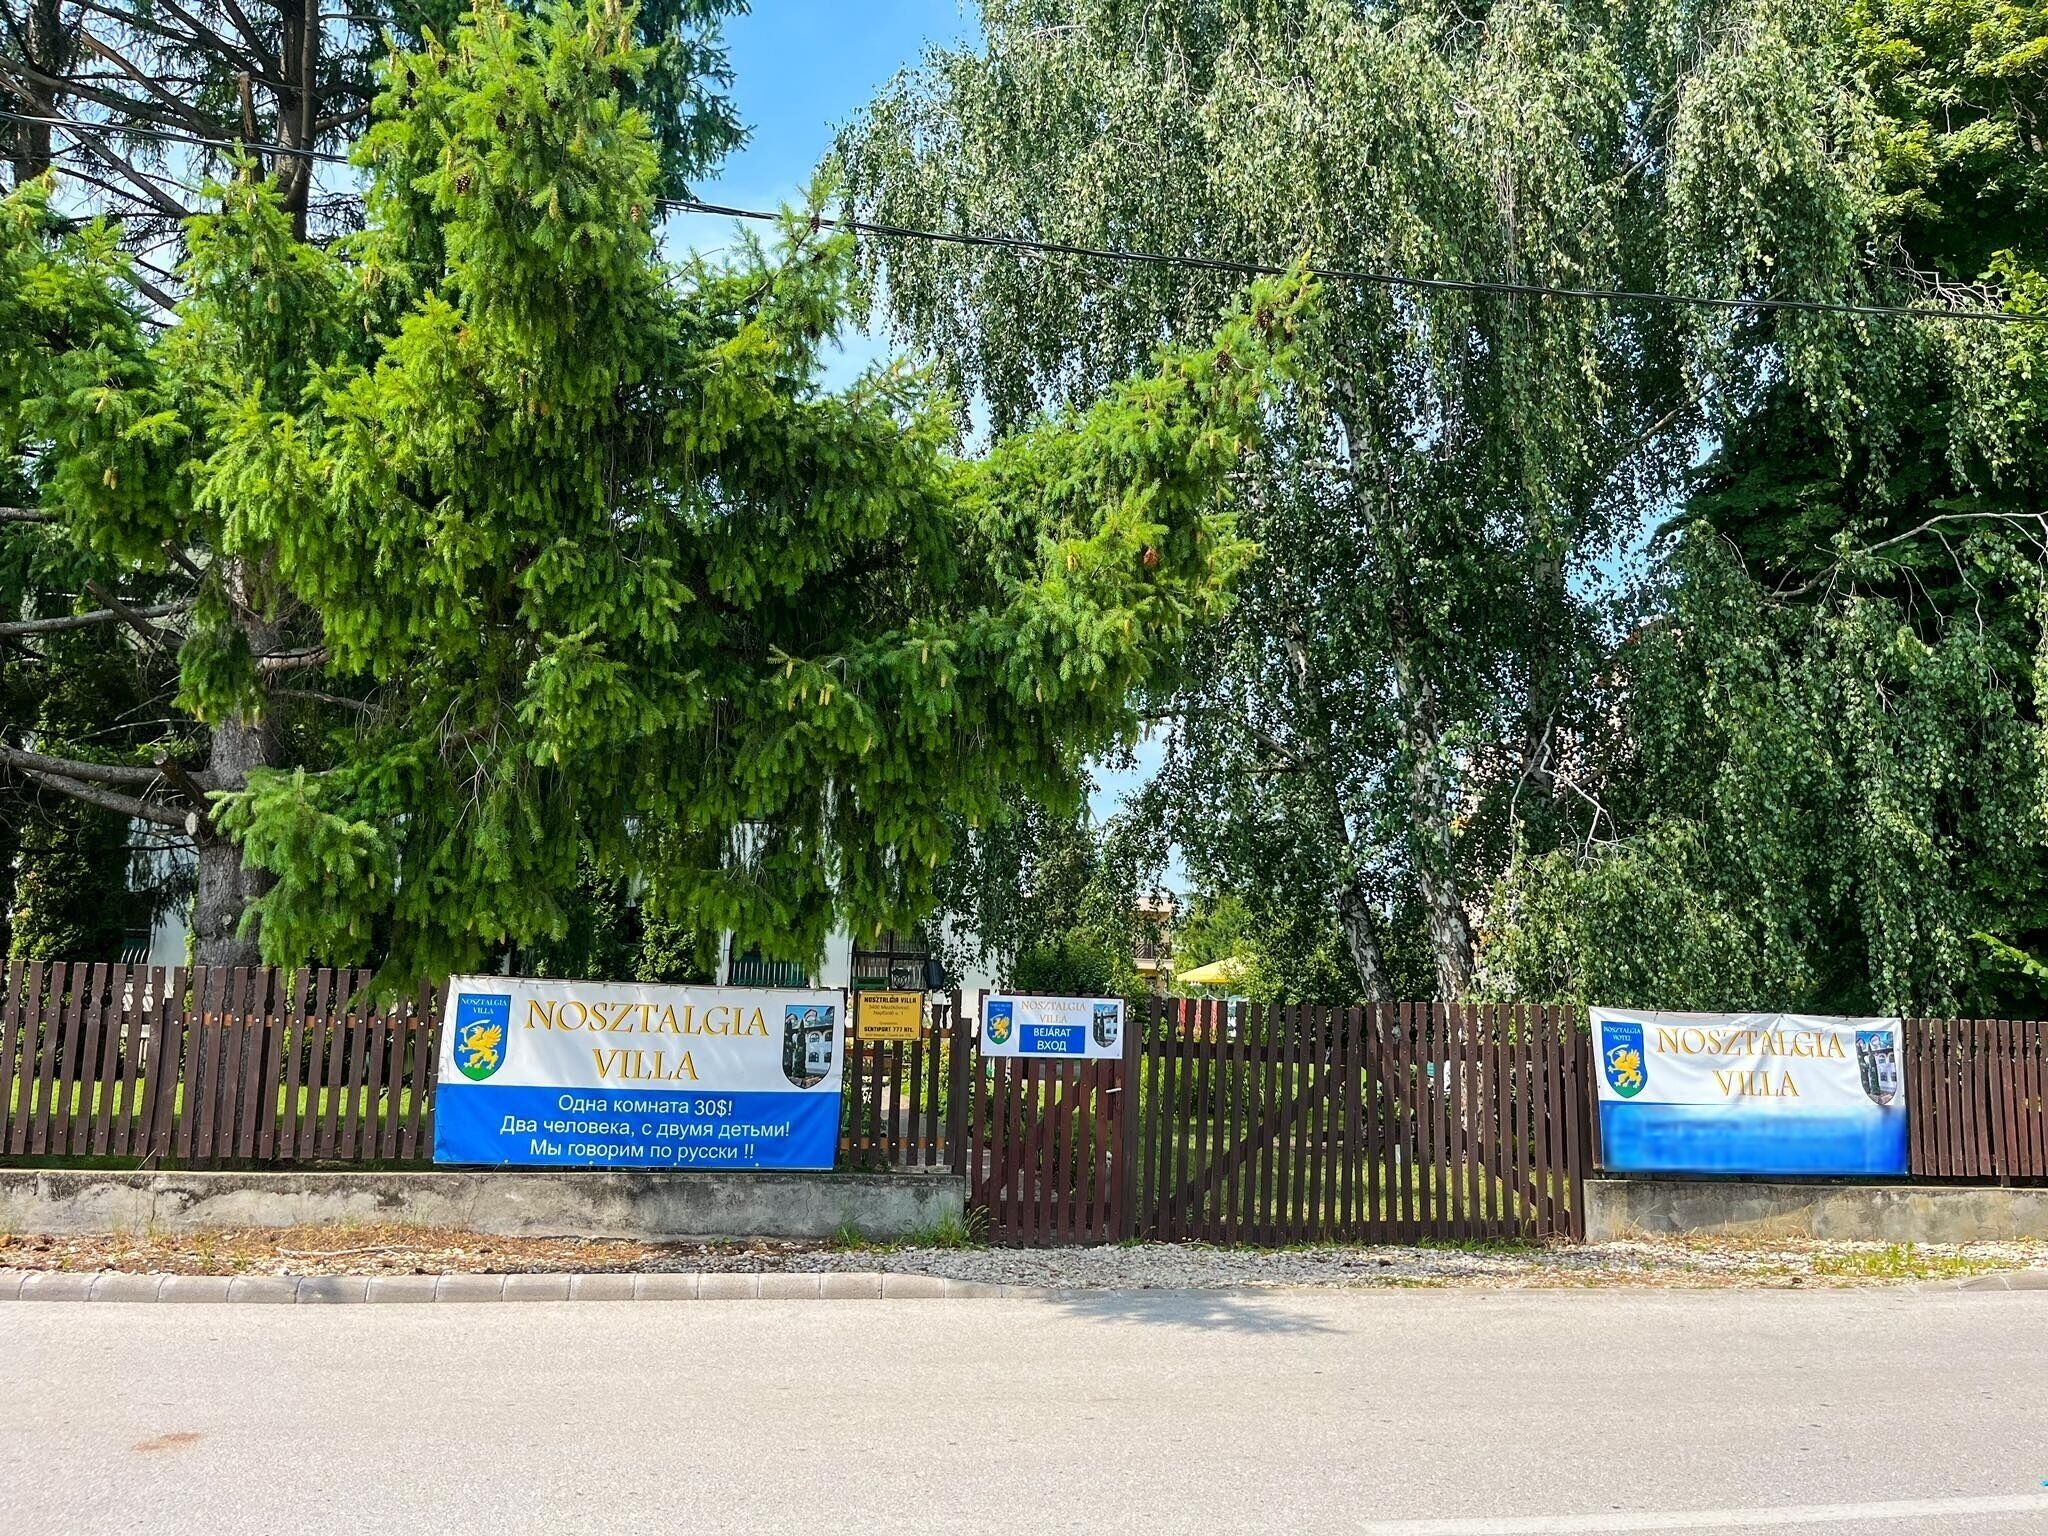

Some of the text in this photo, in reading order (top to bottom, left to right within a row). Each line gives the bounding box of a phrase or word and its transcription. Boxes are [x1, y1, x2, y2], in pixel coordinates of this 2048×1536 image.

[461, 998, 507, 1006] NOSZTALGIA
[1021, 1000, 1087, 1012] NOSZTALGIA
[473, 1007, 494, 1015] VILLA
[524, 999, 769, 1037] NOSZTALGIA
[1040, 1014, 1068, 1024] VILLA
[1033, 1027, 1072, 1037] BEJÁRAT
[1603, 1026, 1641, 1035] NOSZTALGIA
[1037, 1040, 1067, 1052] ВХОД
[1656, 1027, 1846, 1059] NOSZTALGIA
[592, 1048, 699, 1081] VILLA
[1712, 1069, 1800, 1098] VILLA
[558, 1094, 733, 1117] Одна комната 30$!
[500, 1115, 790, 1140] Два человека, с двумя детьми!
[530, 1138, 562, 1156] Мы
[567, 1143, 644, 1160] говорим
[650, 1145, 672, 1158] по
[678, 1146, 738, 1162] русски
